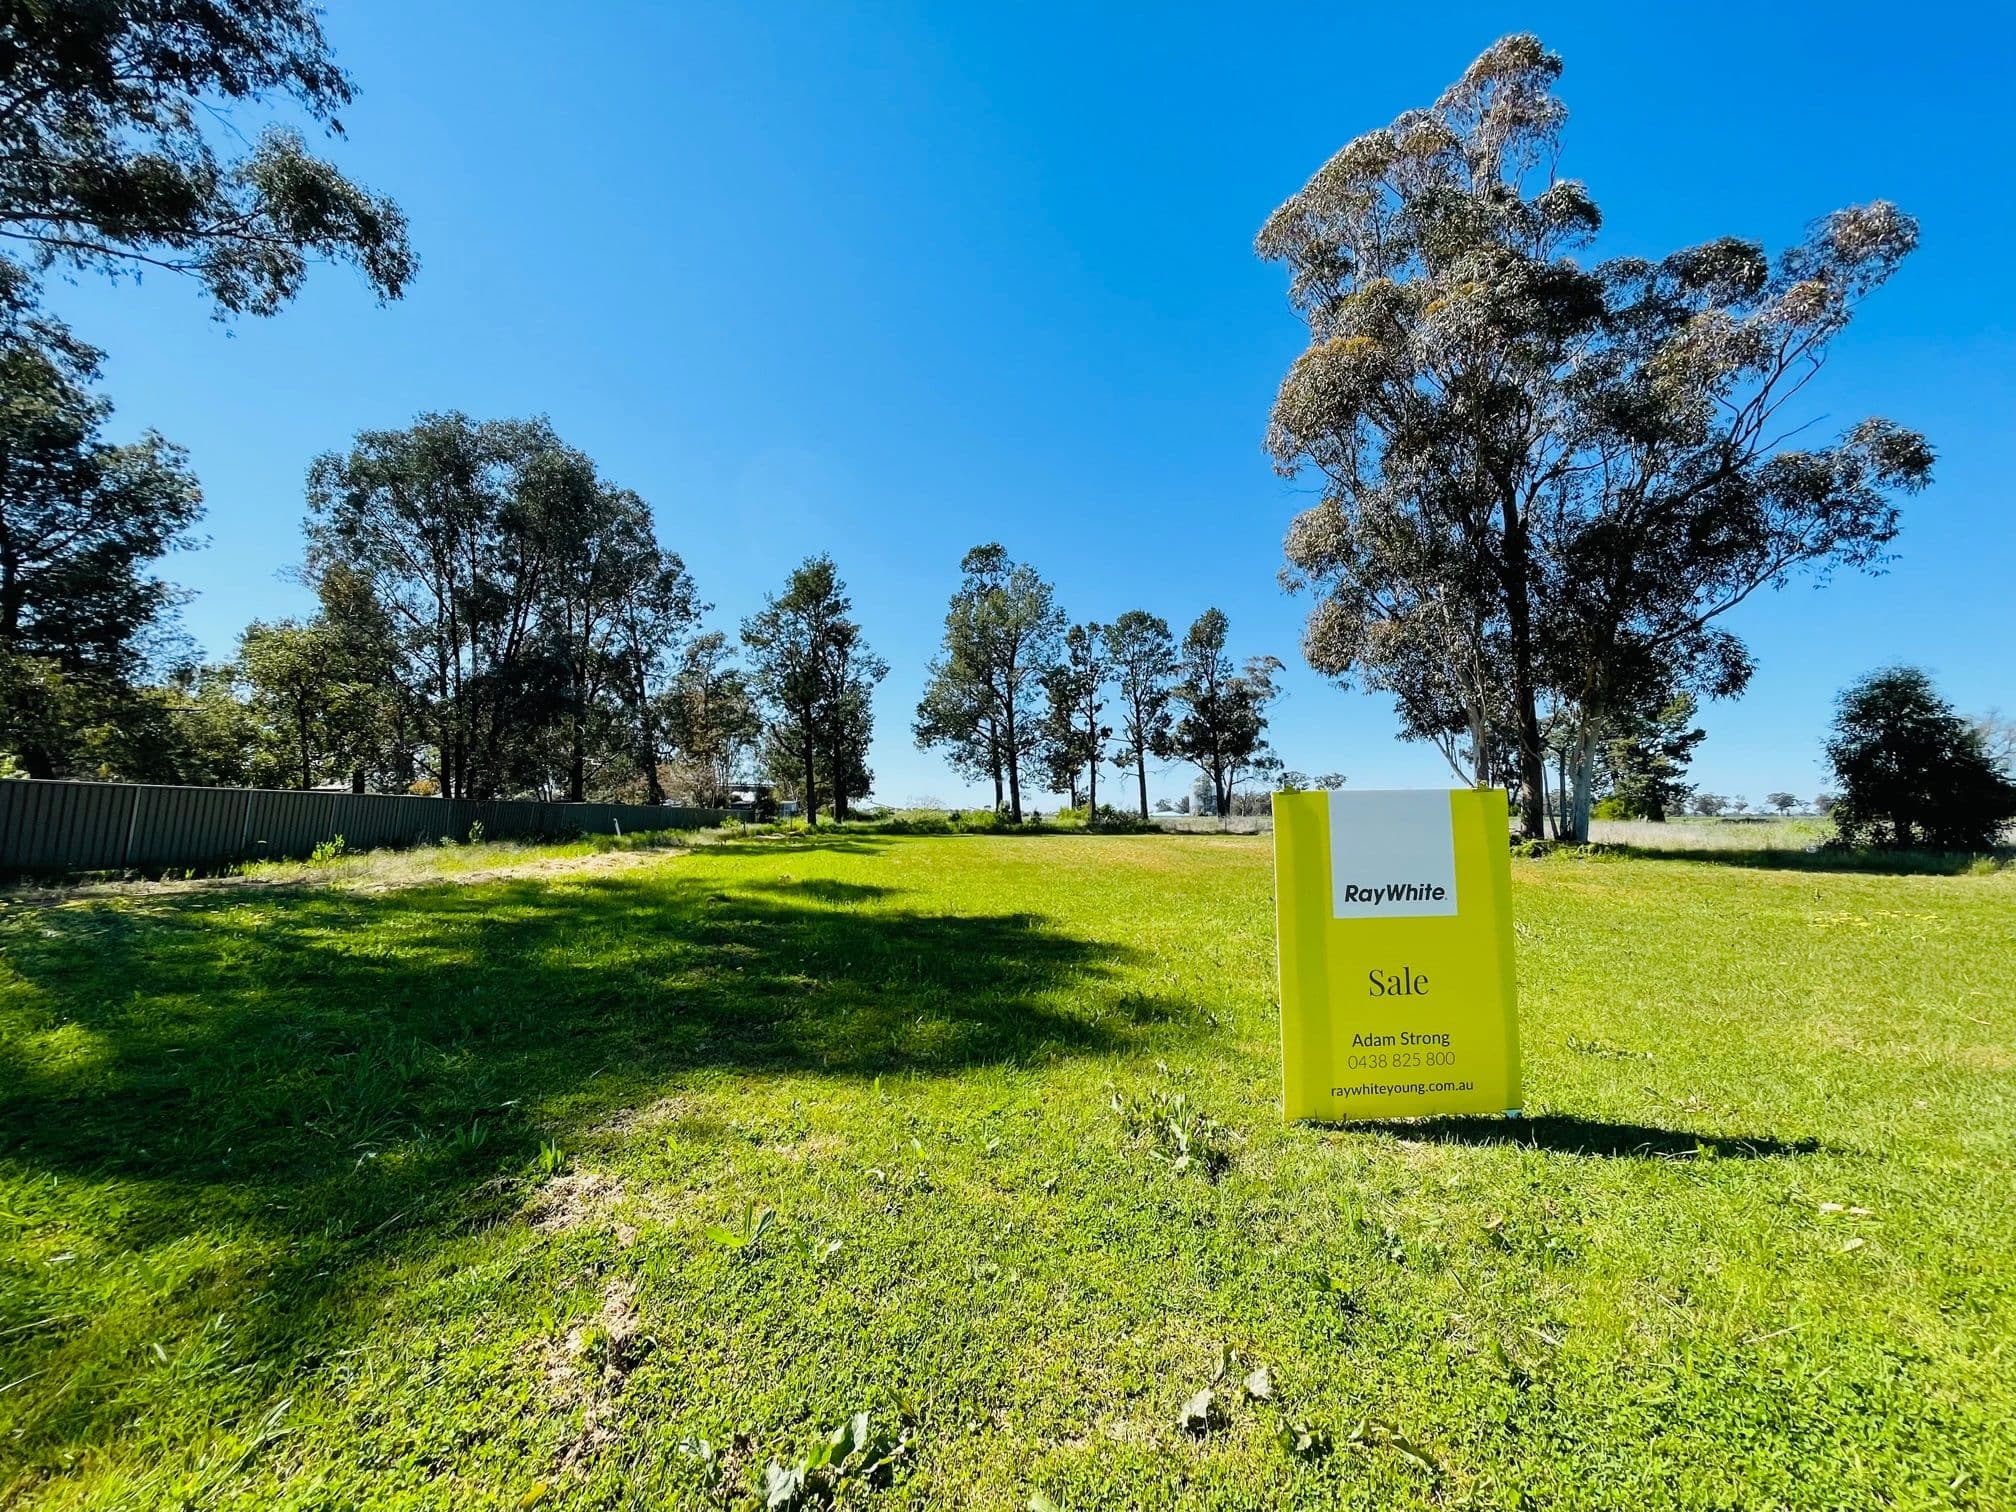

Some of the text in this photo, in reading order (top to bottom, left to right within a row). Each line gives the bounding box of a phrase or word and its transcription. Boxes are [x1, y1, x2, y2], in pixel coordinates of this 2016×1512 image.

[1368, 967, 1429, 997] Sale
[1351, 1031, 1450, 1048] Adam Strong
[1347, 1051, 1456, 1070] 0438 825 800
[1331, 1080, 1474, 1098] raywhiteyoung.com.au
